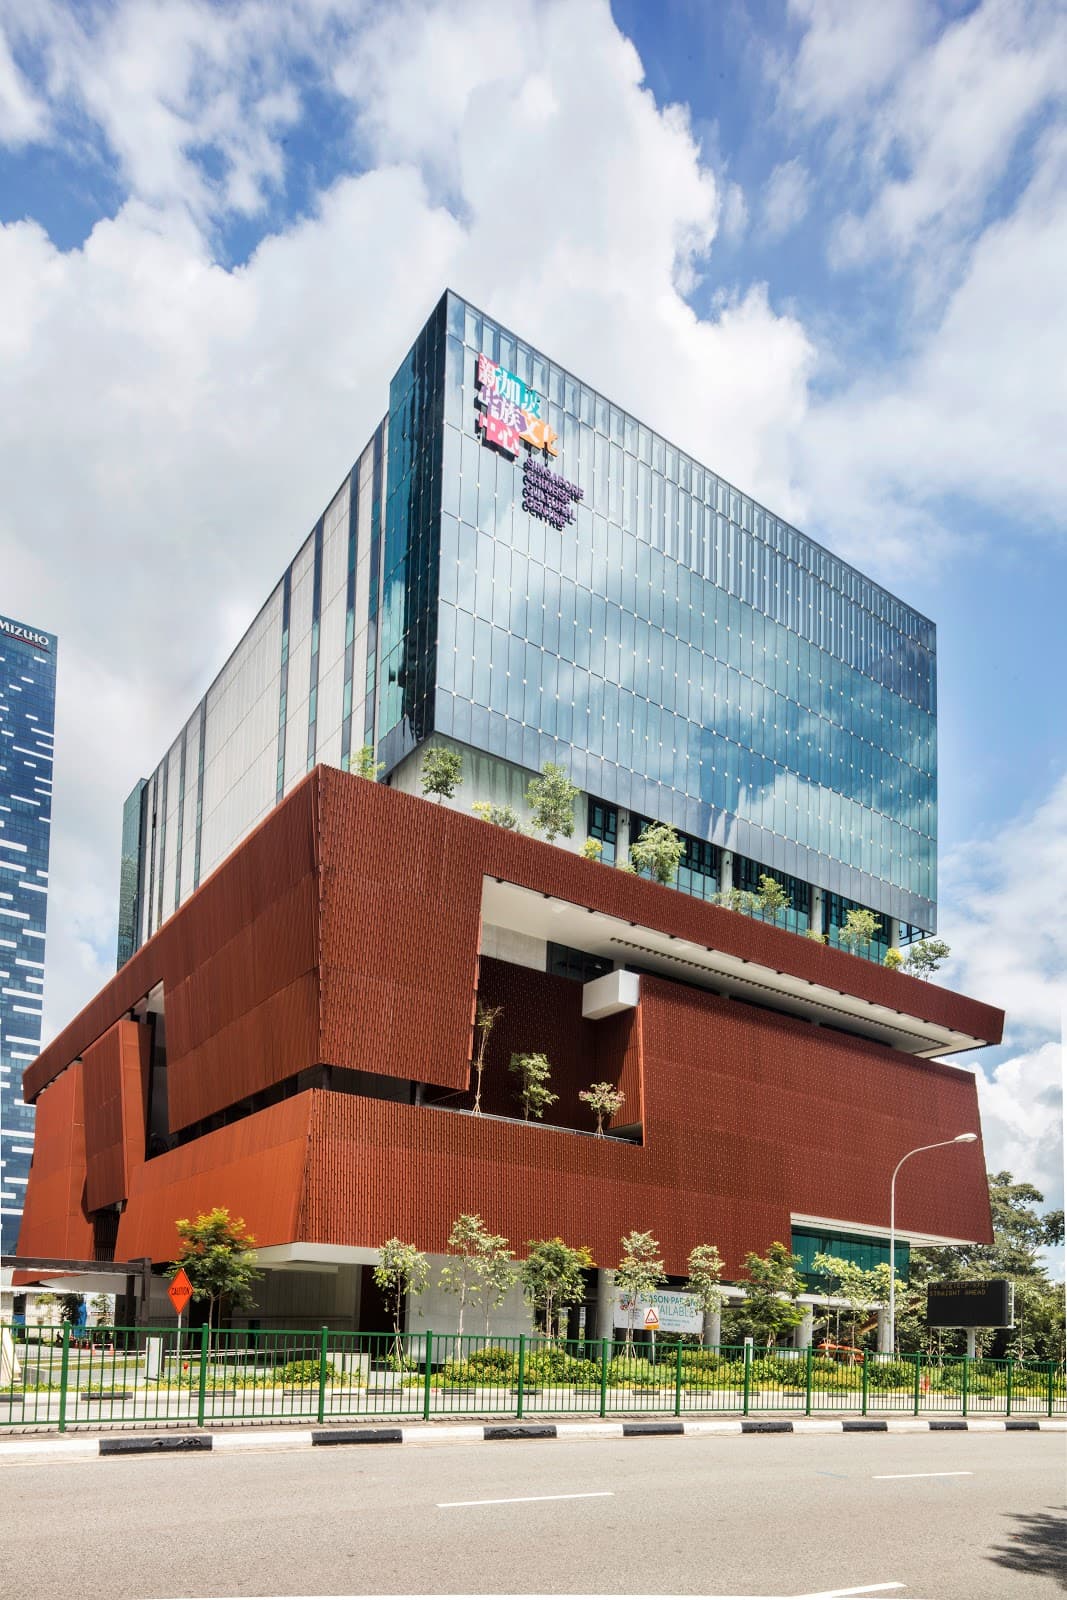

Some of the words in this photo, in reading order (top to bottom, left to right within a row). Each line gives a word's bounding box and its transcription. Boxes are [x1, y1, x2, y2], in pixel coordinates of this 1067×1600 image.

[478, 352, 541, 419] 新加坡
[479, 412, 520, 457] 中心
[526, 470, 571, 504] CHINESE
[527, 457, 584, 500] SINGAPORE
[526, 483, 576, 522] CULTURAL
[526, 496, 565, 528] CENTRE
[0, 619, 49, 646] MIZUHO
[171, 1286, 190, 1296] CAUTION
[640, 1293, 669, 1305] SASON
